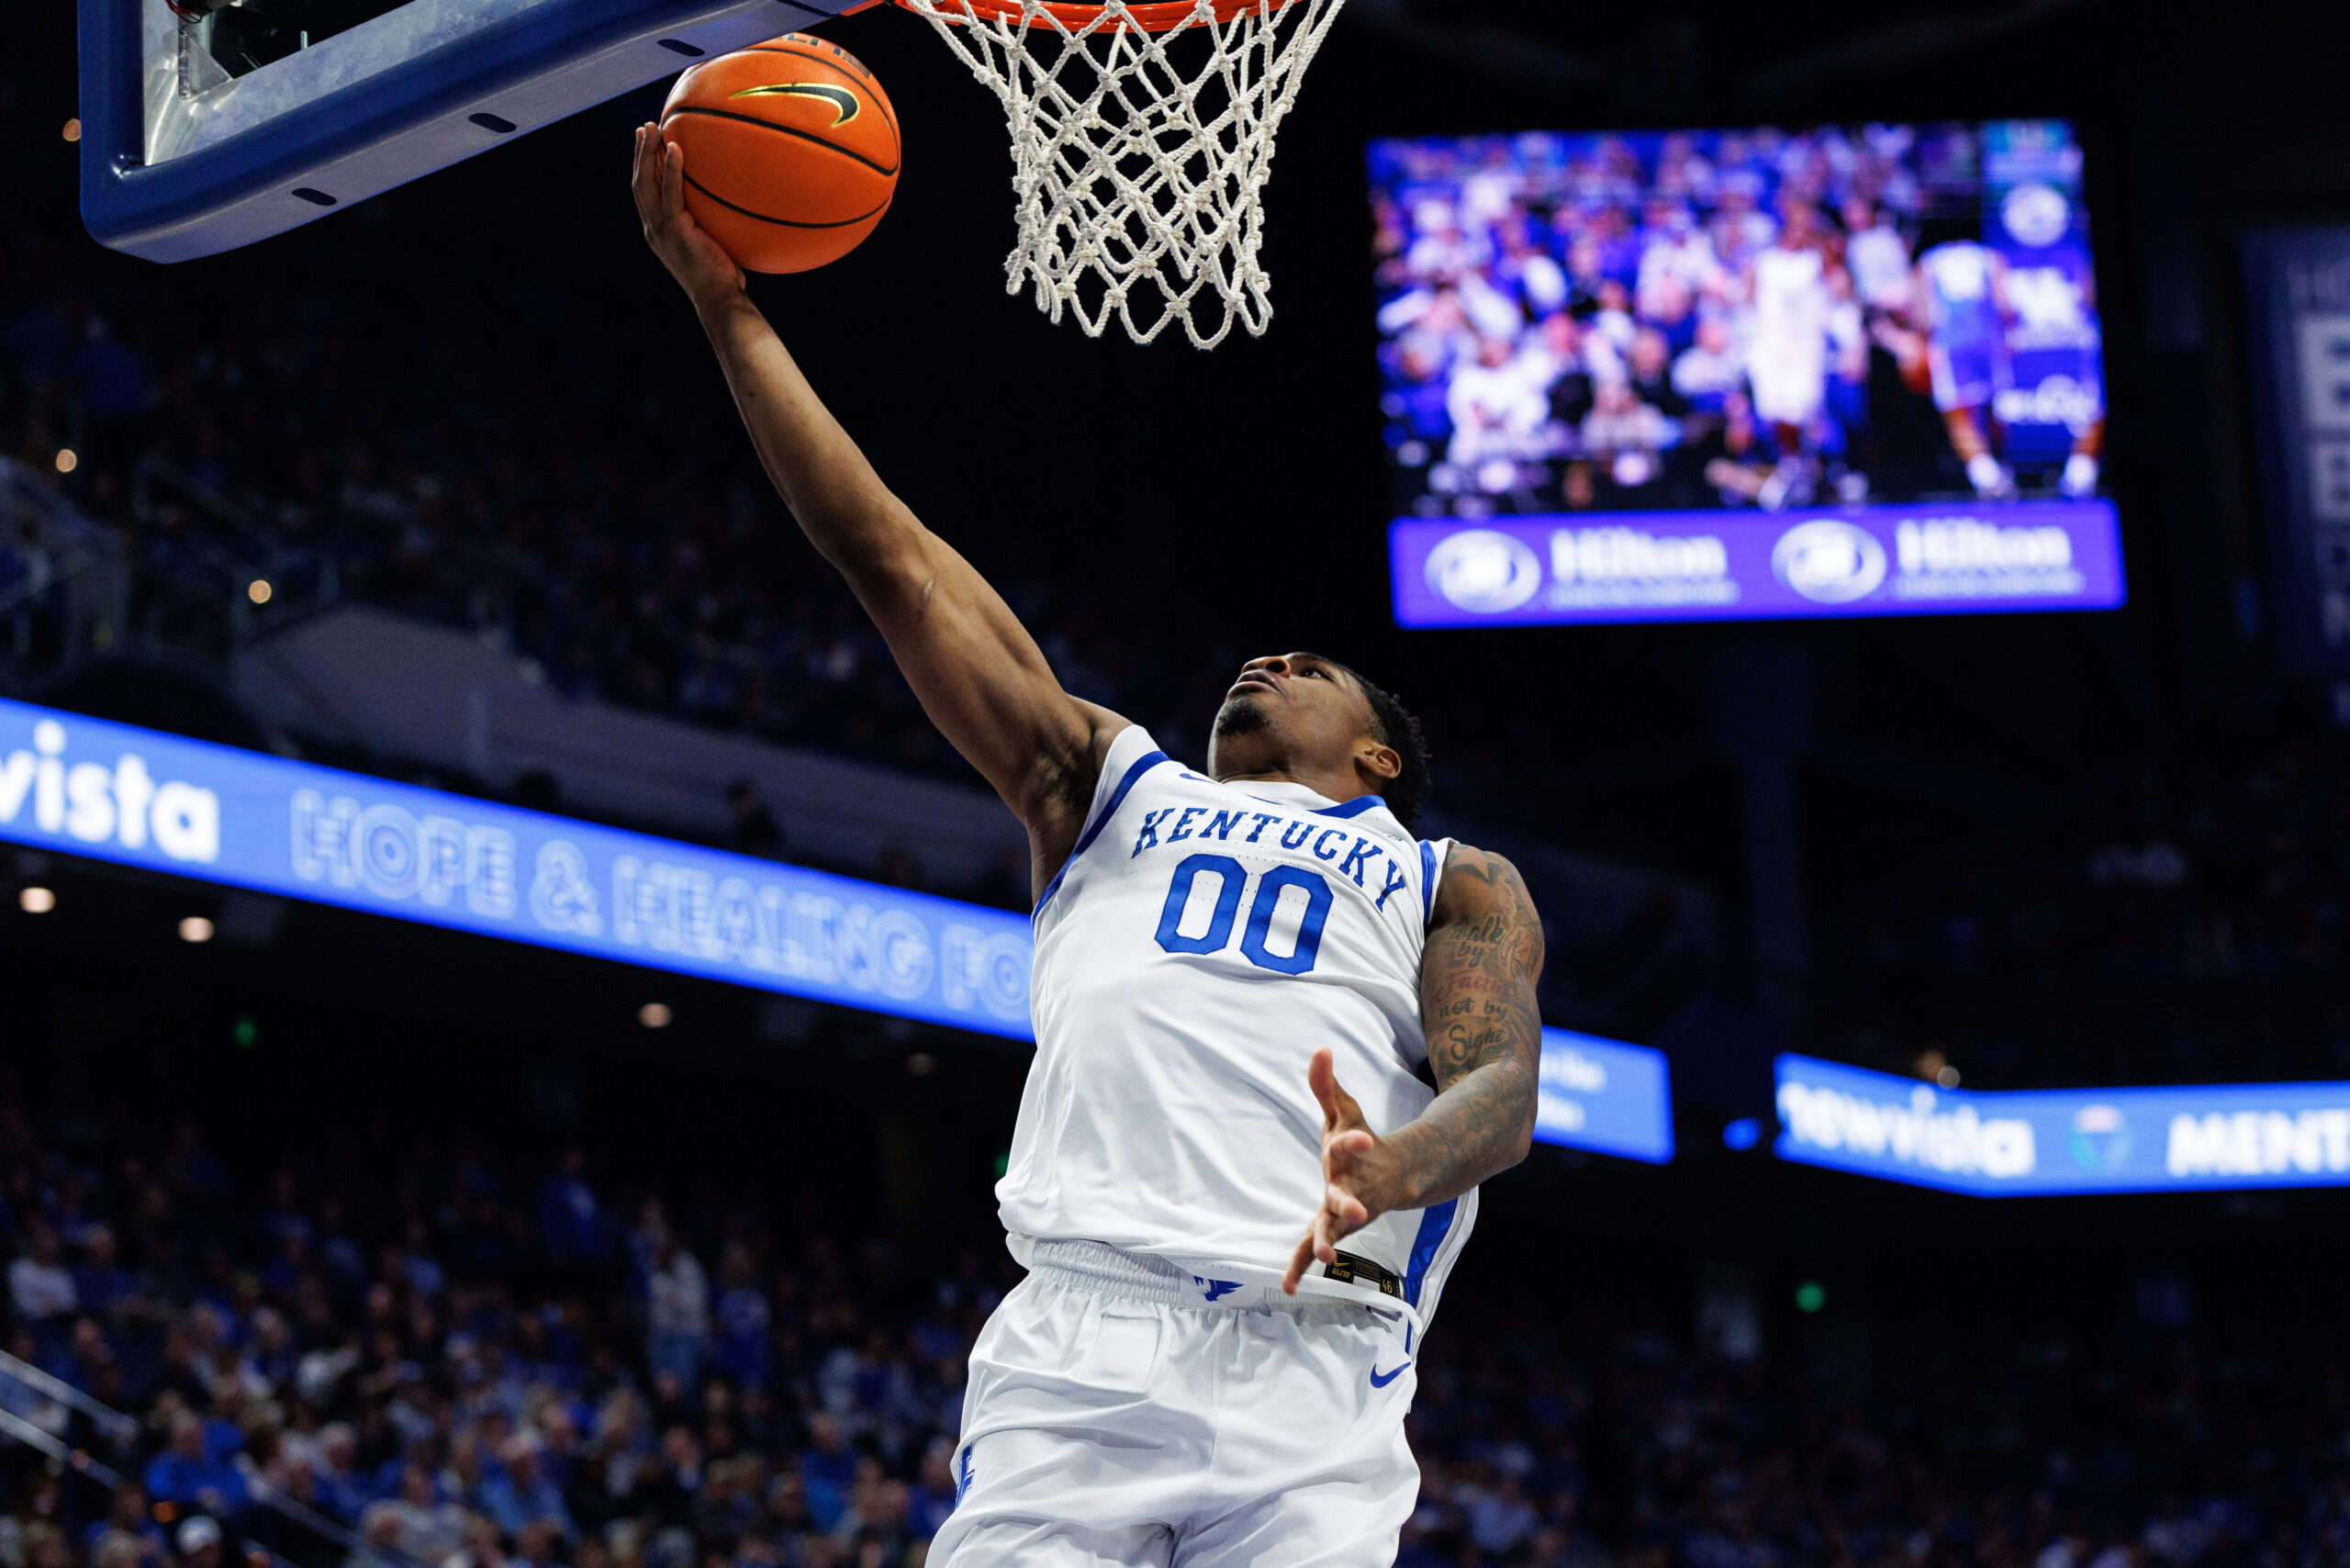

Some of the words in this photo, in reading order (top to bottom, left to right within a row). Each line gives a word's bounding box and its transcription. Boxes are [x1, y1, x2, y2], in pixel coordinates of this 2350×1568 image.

[290, 788, 518, 919] HOPE
[530, 839, 603, 937] &
[612, 855, 934, 1001] HEALING
[1131, 807, 1405, 913] KENTUCKY
[1154, 853, 1334, 976] 00
[1440, 995, 1476, 1019] not
[1449, 1024, 1507, 1061] Sight
[1382, 1278, 1393, 1294] 46
